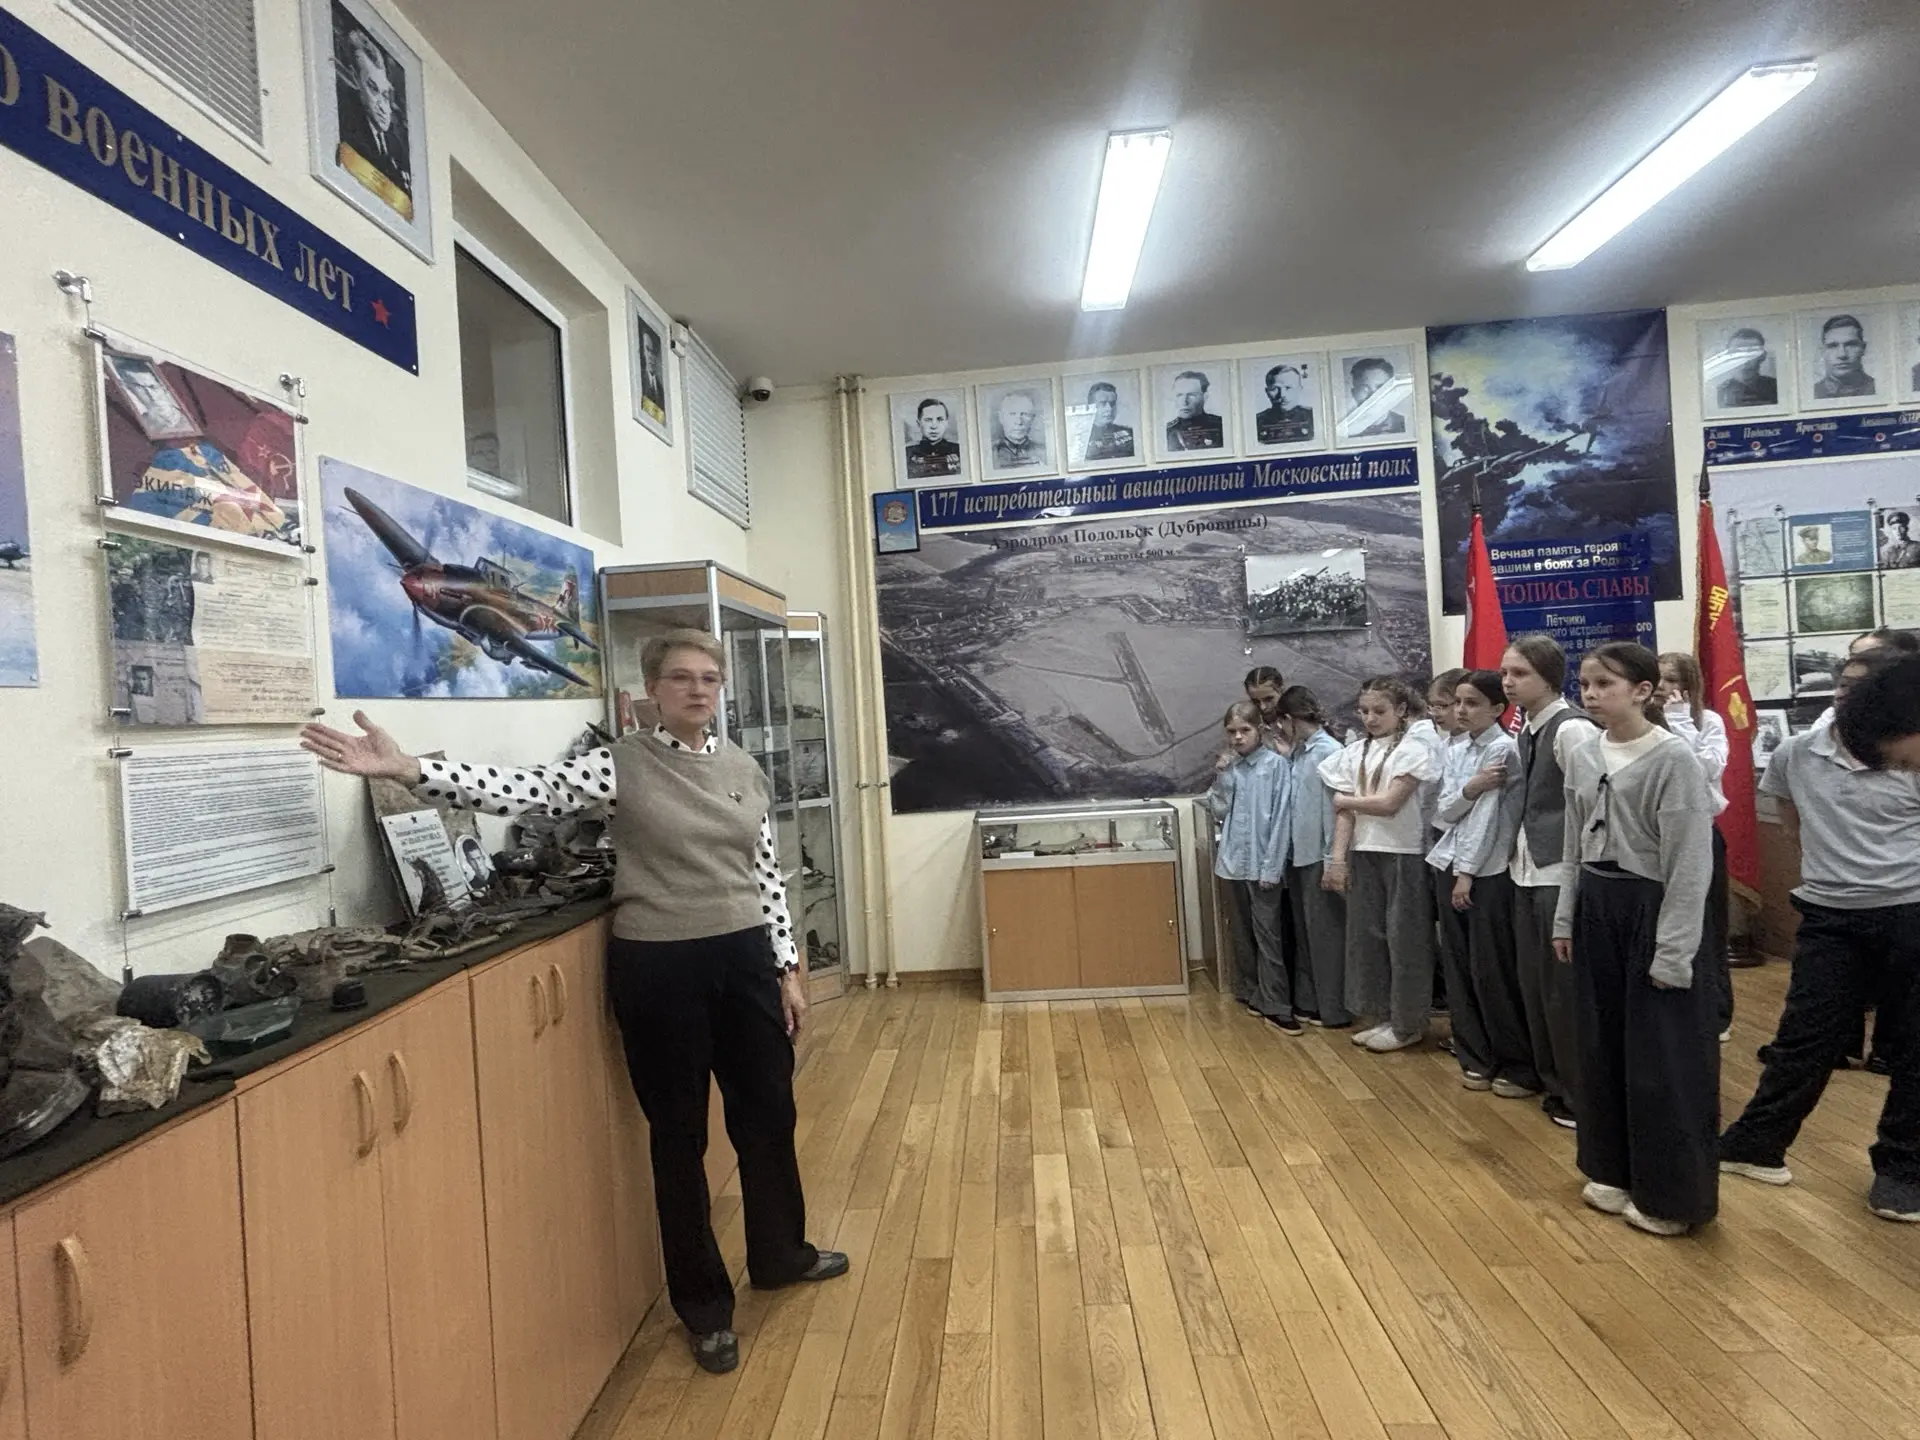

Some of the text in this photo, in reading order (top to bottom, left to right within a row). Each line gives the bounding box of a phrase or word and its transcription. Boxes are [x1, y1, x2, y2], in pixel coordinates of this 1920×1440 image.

[44, 74, 284, 271] военных
[294, 240, 355, 313] лет
[930, 456, 1412, 518] 177 истребительный авиационный Московский полк
[989, 512, 1268, 551] Аэродром Подольск (Дубровицы)
[1490, 549, 1535, 561] Вечная
[1537, 546, 1582, 558] память
[1490, 563, 1531, 575] авшим
[1534, 562, 1542, 571] в
[1544, 558, 1574, 570] боях
[1576, 558, 1590, 568] за
[1503, 575, 1651, 604] ТОПИСЬ СЛАВЫ
[1546, 613, 1586, 627] Лётчики
